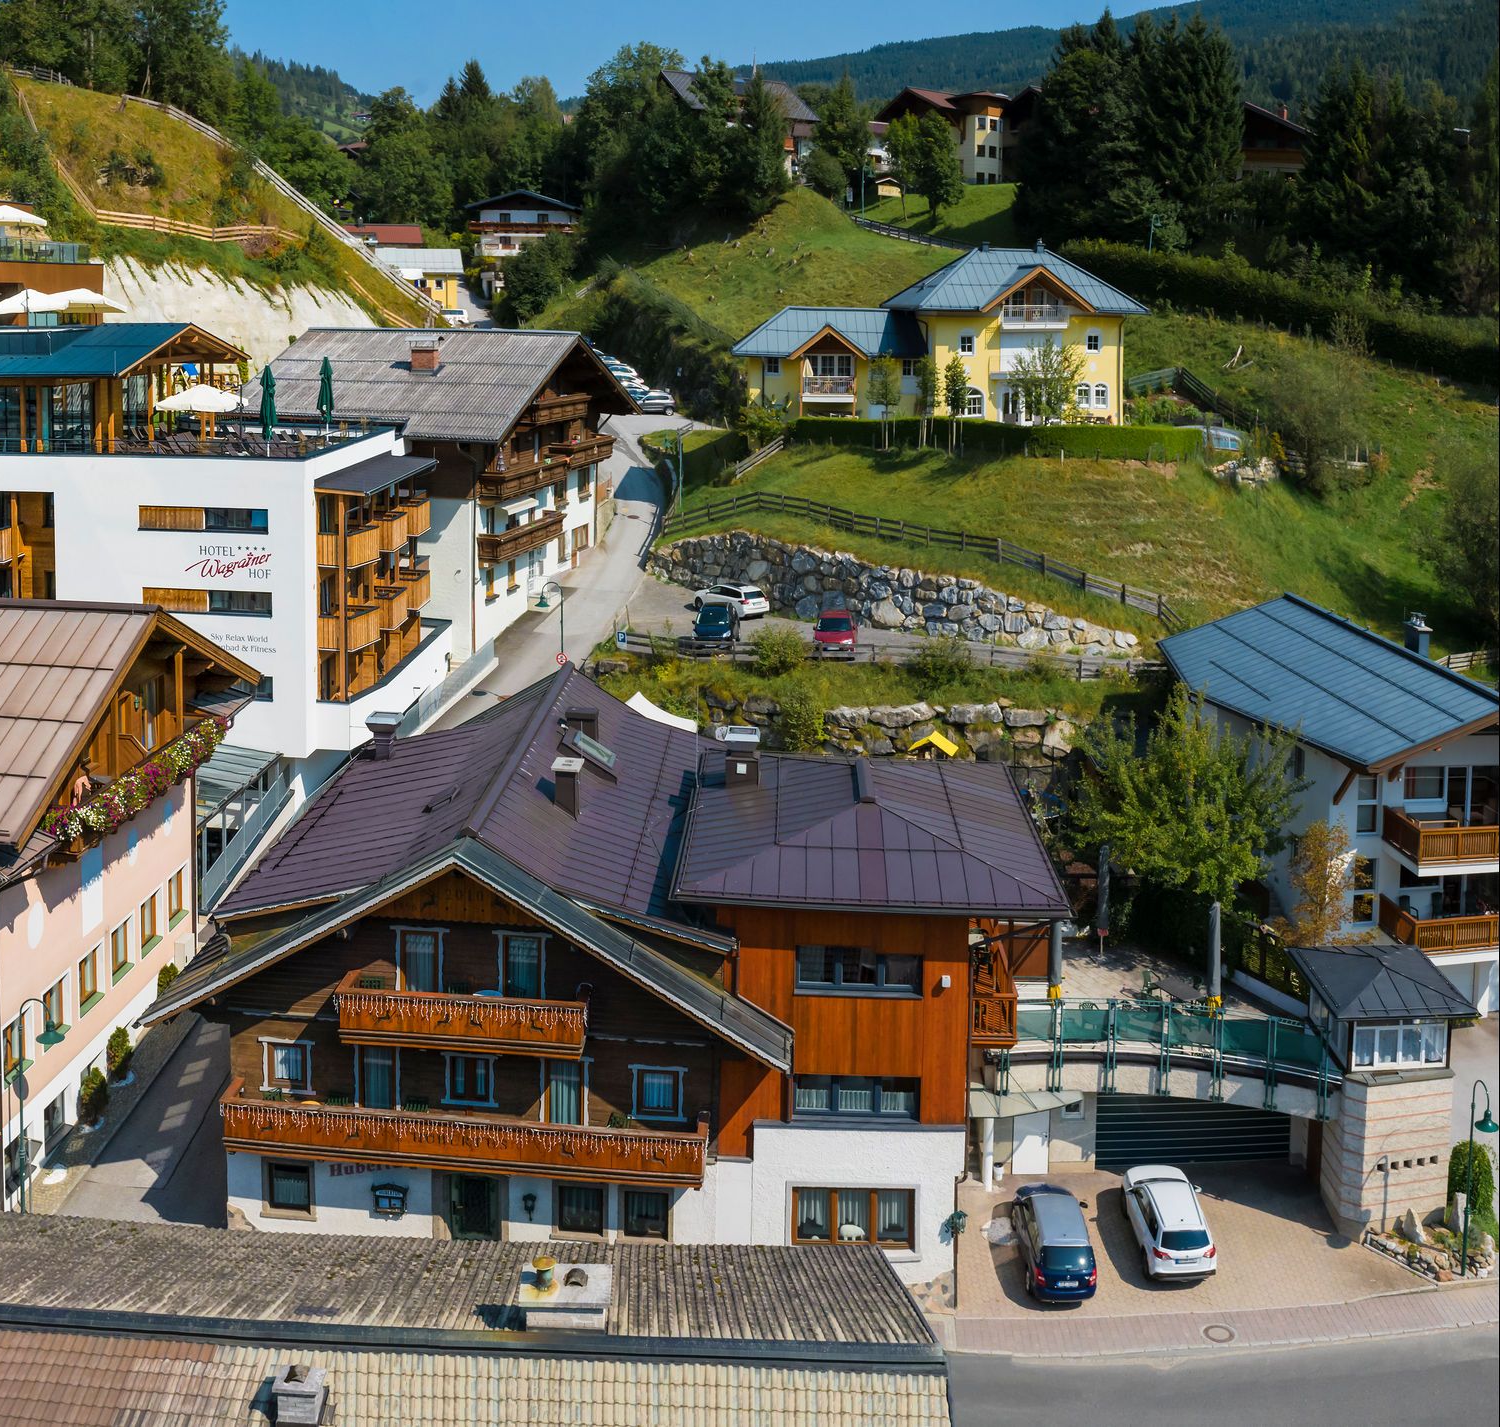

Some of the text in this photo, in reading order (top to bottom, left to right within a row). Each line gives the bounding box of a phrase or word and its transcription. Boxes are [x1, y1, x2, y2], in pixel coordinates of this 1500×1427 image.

[199, 545, 235, 557] HOTEL
[185, 552, 272, 578] Wagrainer
[248, 568, 271, 579] HOF
[210, 633, 268, 643] Sky Relax World
[250, 645, 277, 653] Fitness
